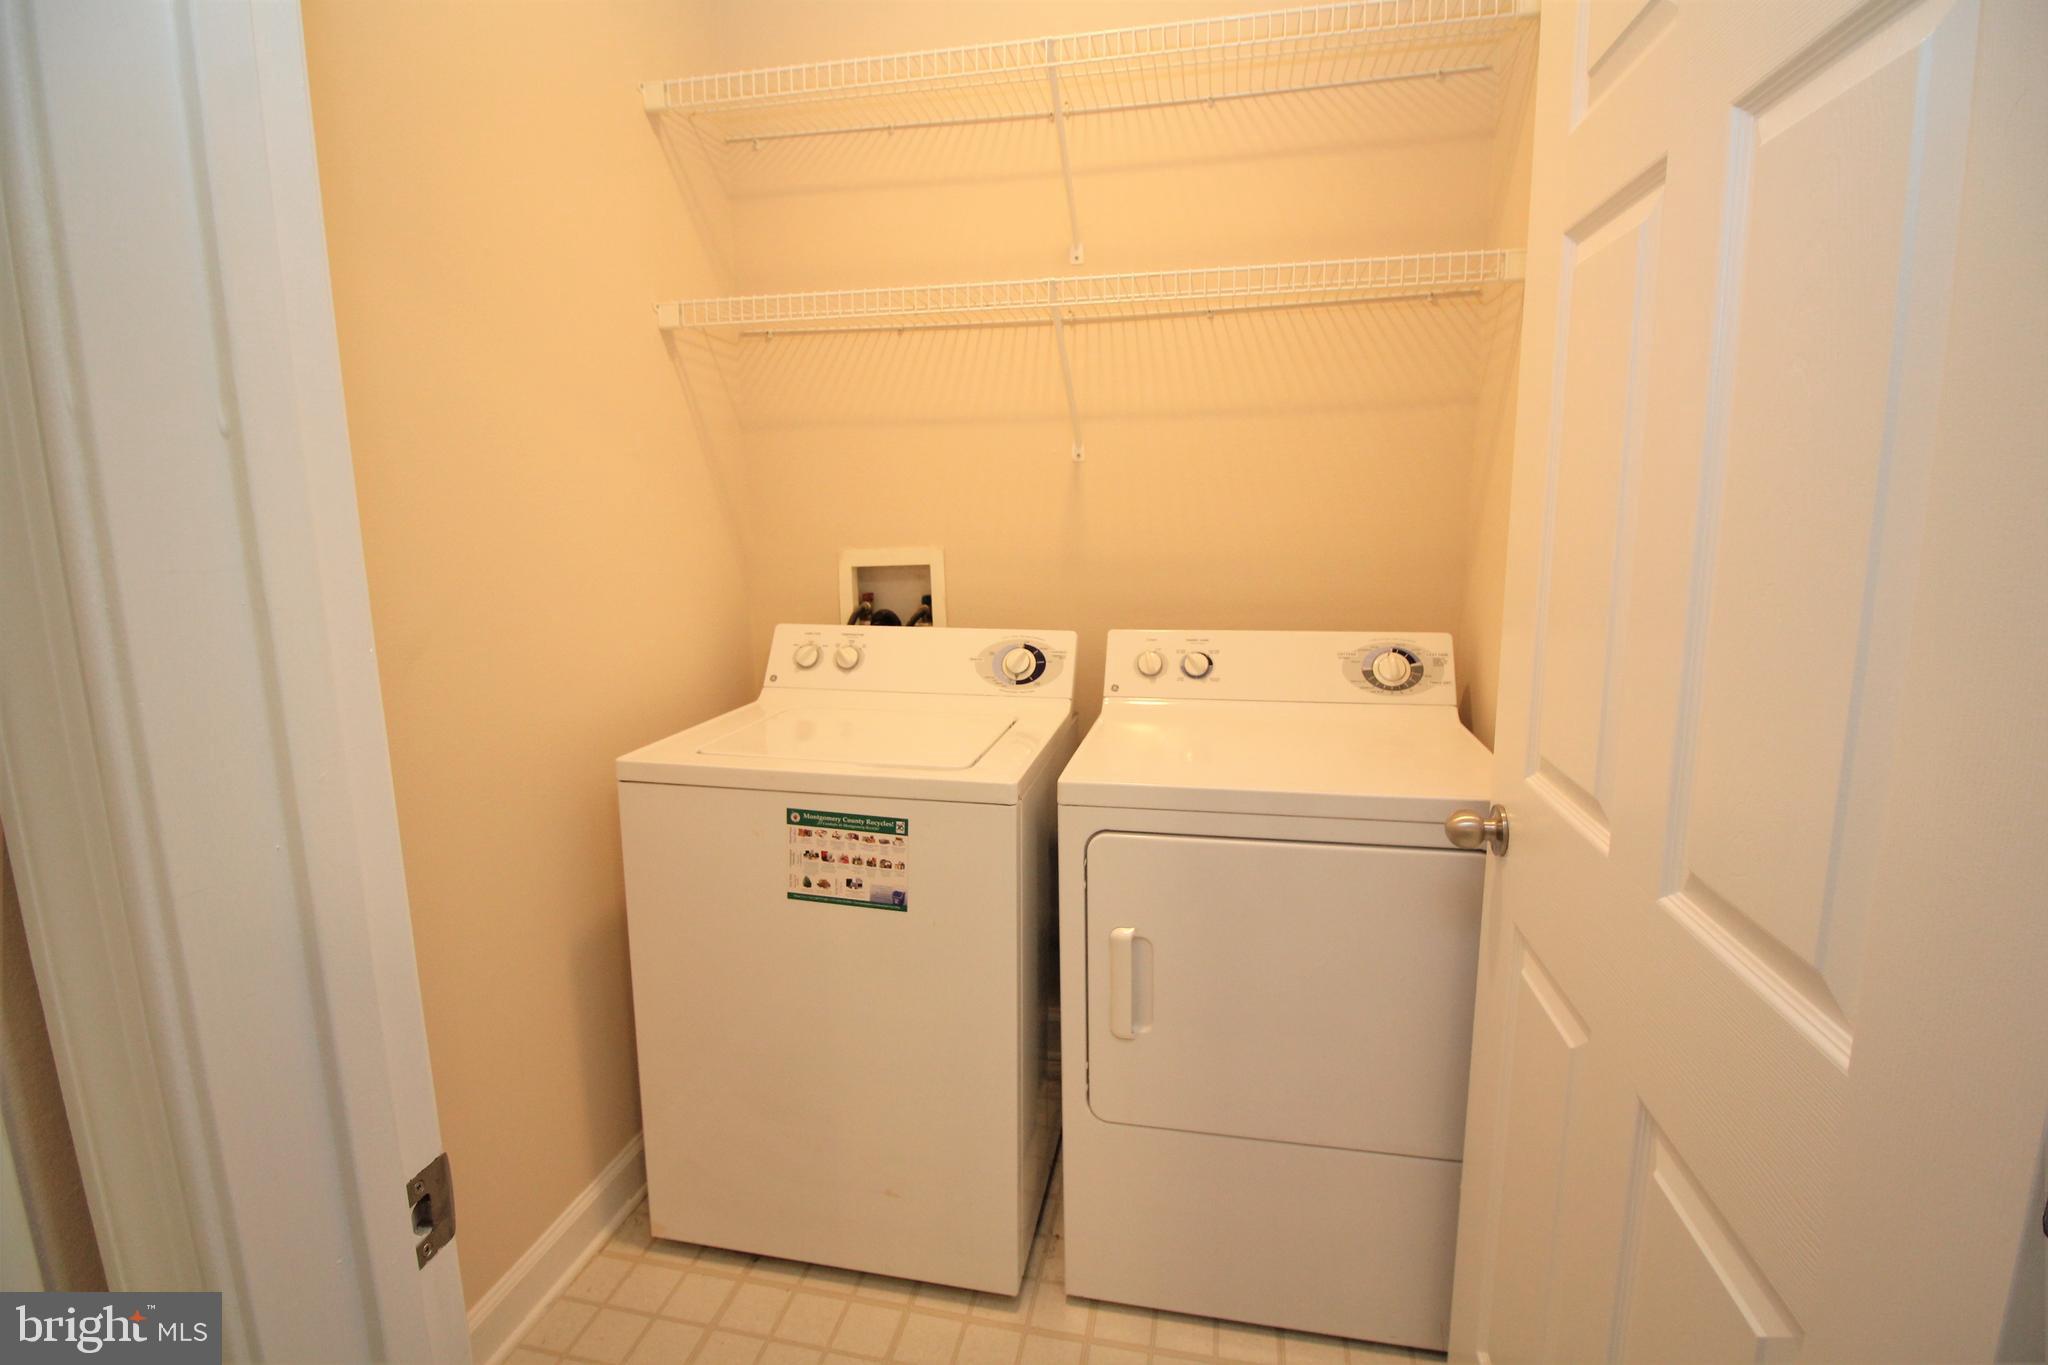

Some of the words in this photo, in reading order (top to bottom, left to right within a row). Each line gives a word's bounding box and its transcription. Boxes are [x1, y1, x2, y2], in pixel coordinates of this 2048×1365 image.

[803, 813, 841, 823] Montgomery
[843, 817, 865, 825] County
[866, 819, 894, 827] Recycles!
